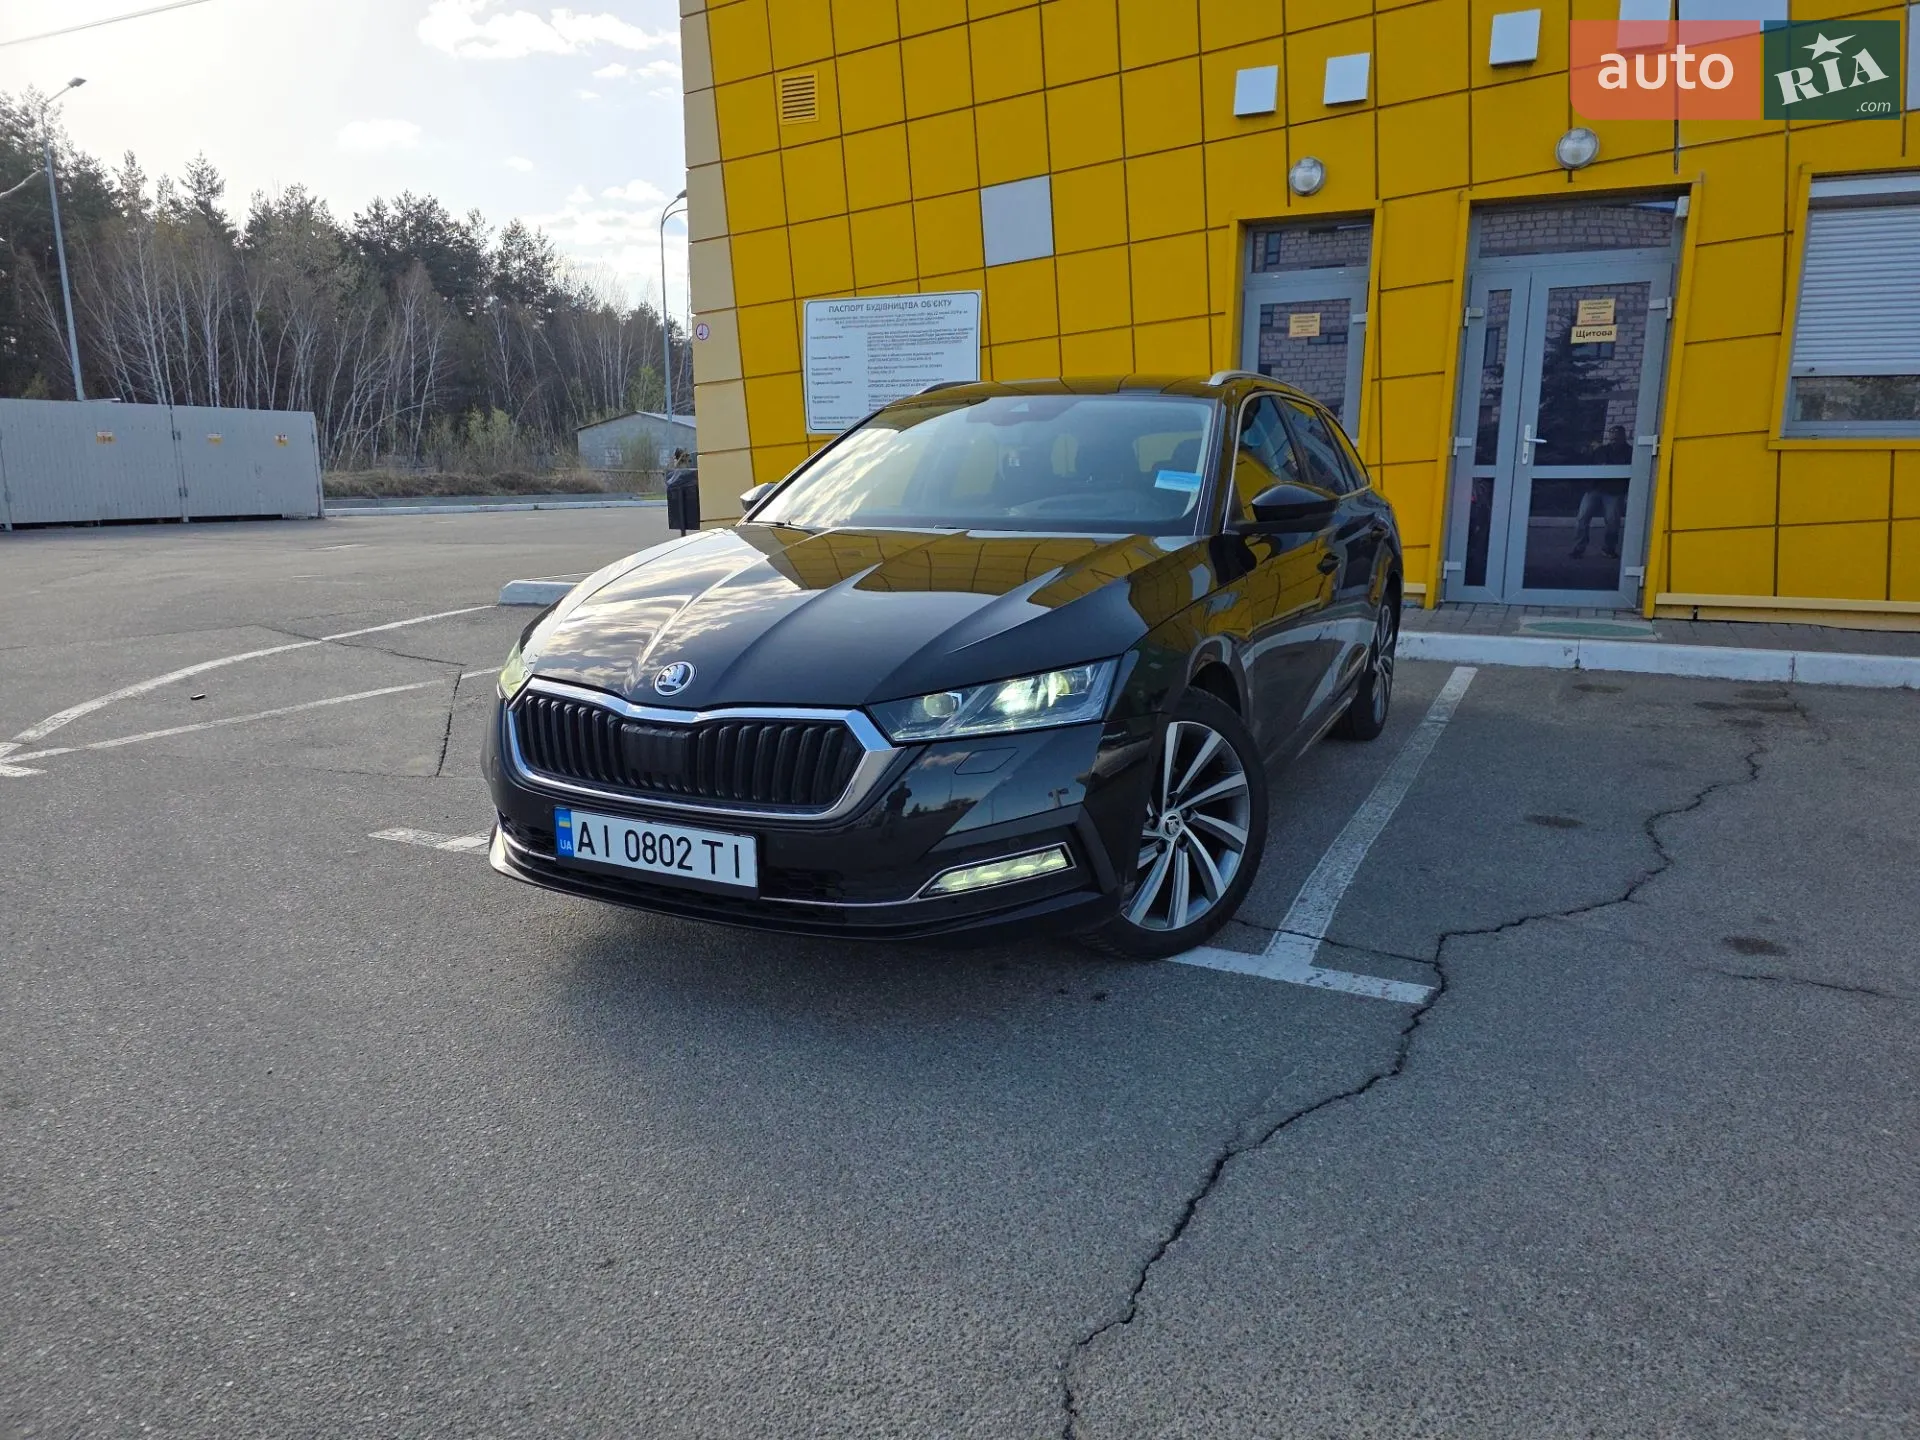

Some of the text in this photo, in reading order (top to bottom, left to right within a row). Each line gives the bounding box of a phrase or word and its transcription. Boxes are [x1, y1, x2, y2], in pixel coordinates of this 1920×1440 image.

[828, 303, 864, 313] ПАСПОРТ
[866, 301, 919, 312] БУДІВНИЦТВА
[1575, 330, 1613, 339] Щитова
[559, 839, 573, 850] UA
[577, 821, 740, 879] AI 0802 TI
